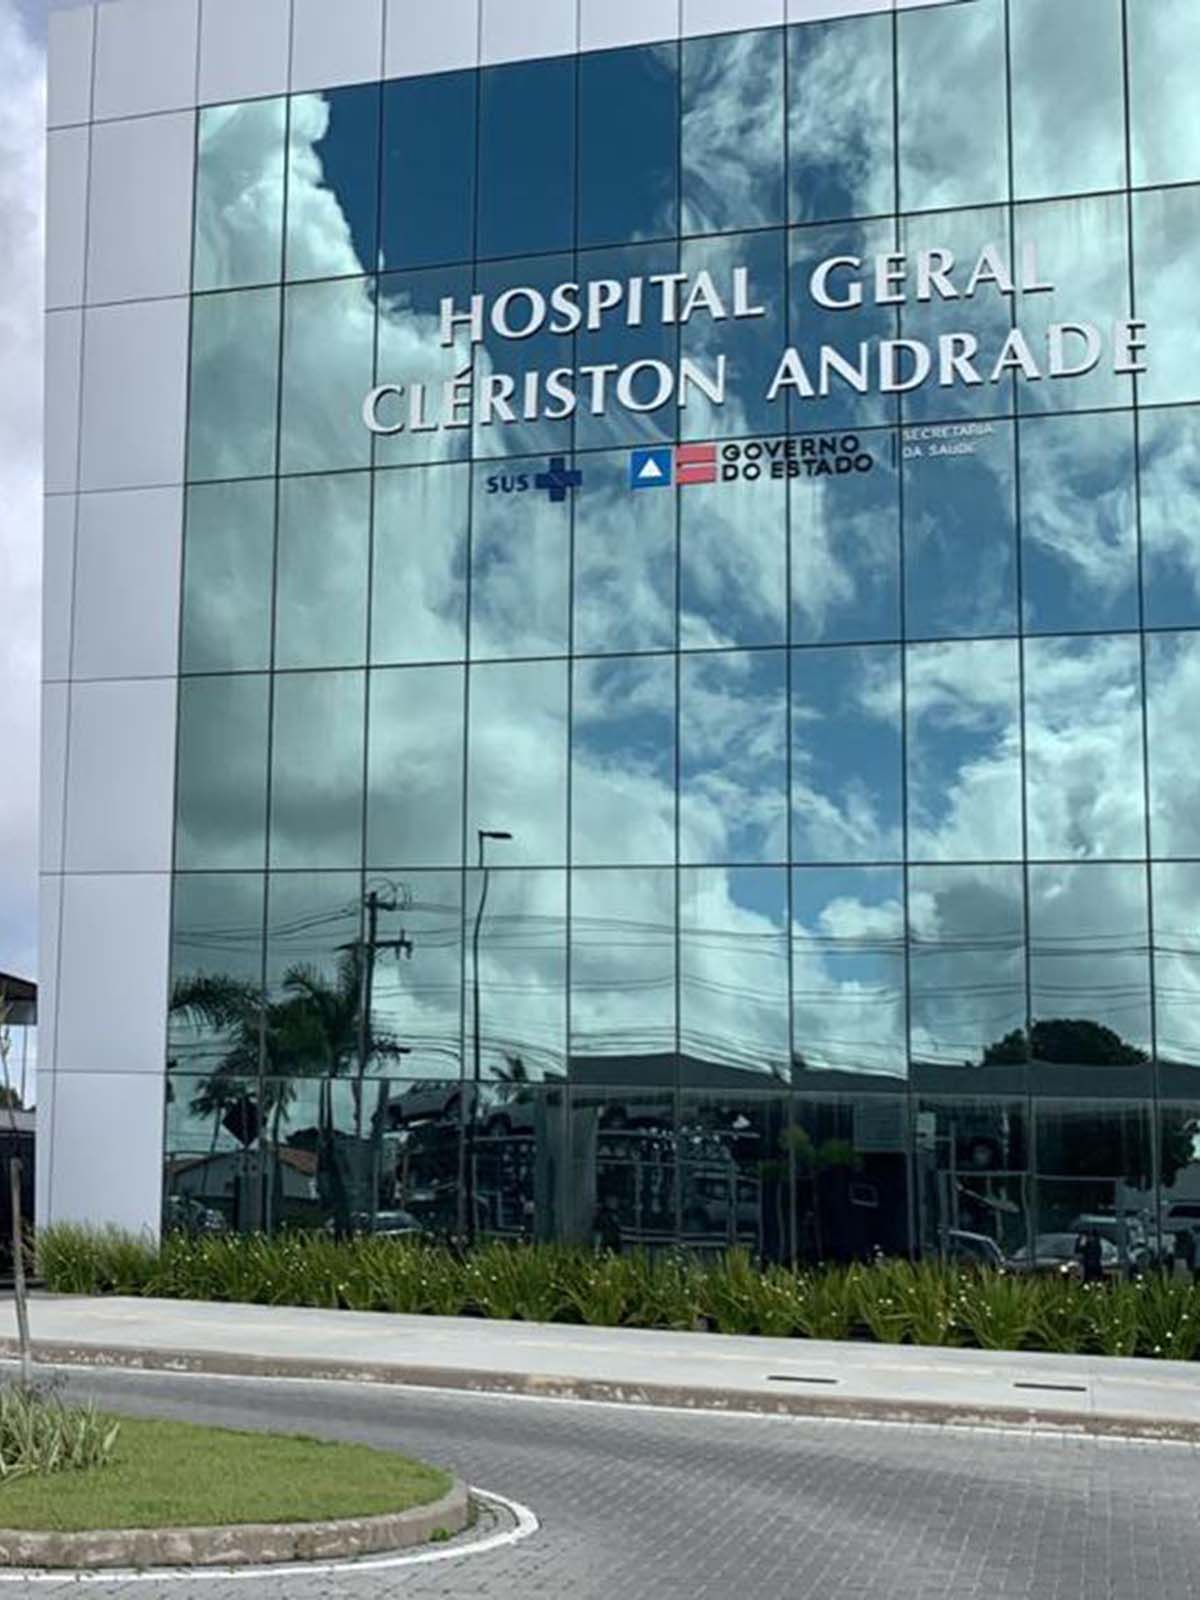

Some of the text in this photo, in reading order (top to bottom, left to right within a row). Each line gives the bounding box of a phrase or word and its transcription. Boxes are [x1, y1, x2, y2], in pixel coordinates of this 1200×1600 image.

[440, 241, 1055, 347] HOSPITAL GERAL
[361, 319, 1148, 435] CLÉRISTON ANDRADE
[721, 434, 860, 463] GOVERNO
[902, 445, 923, 460] DA
[721, 453, 874, 482] DO ESTADO
[485, 473, 531, 494] SUS
